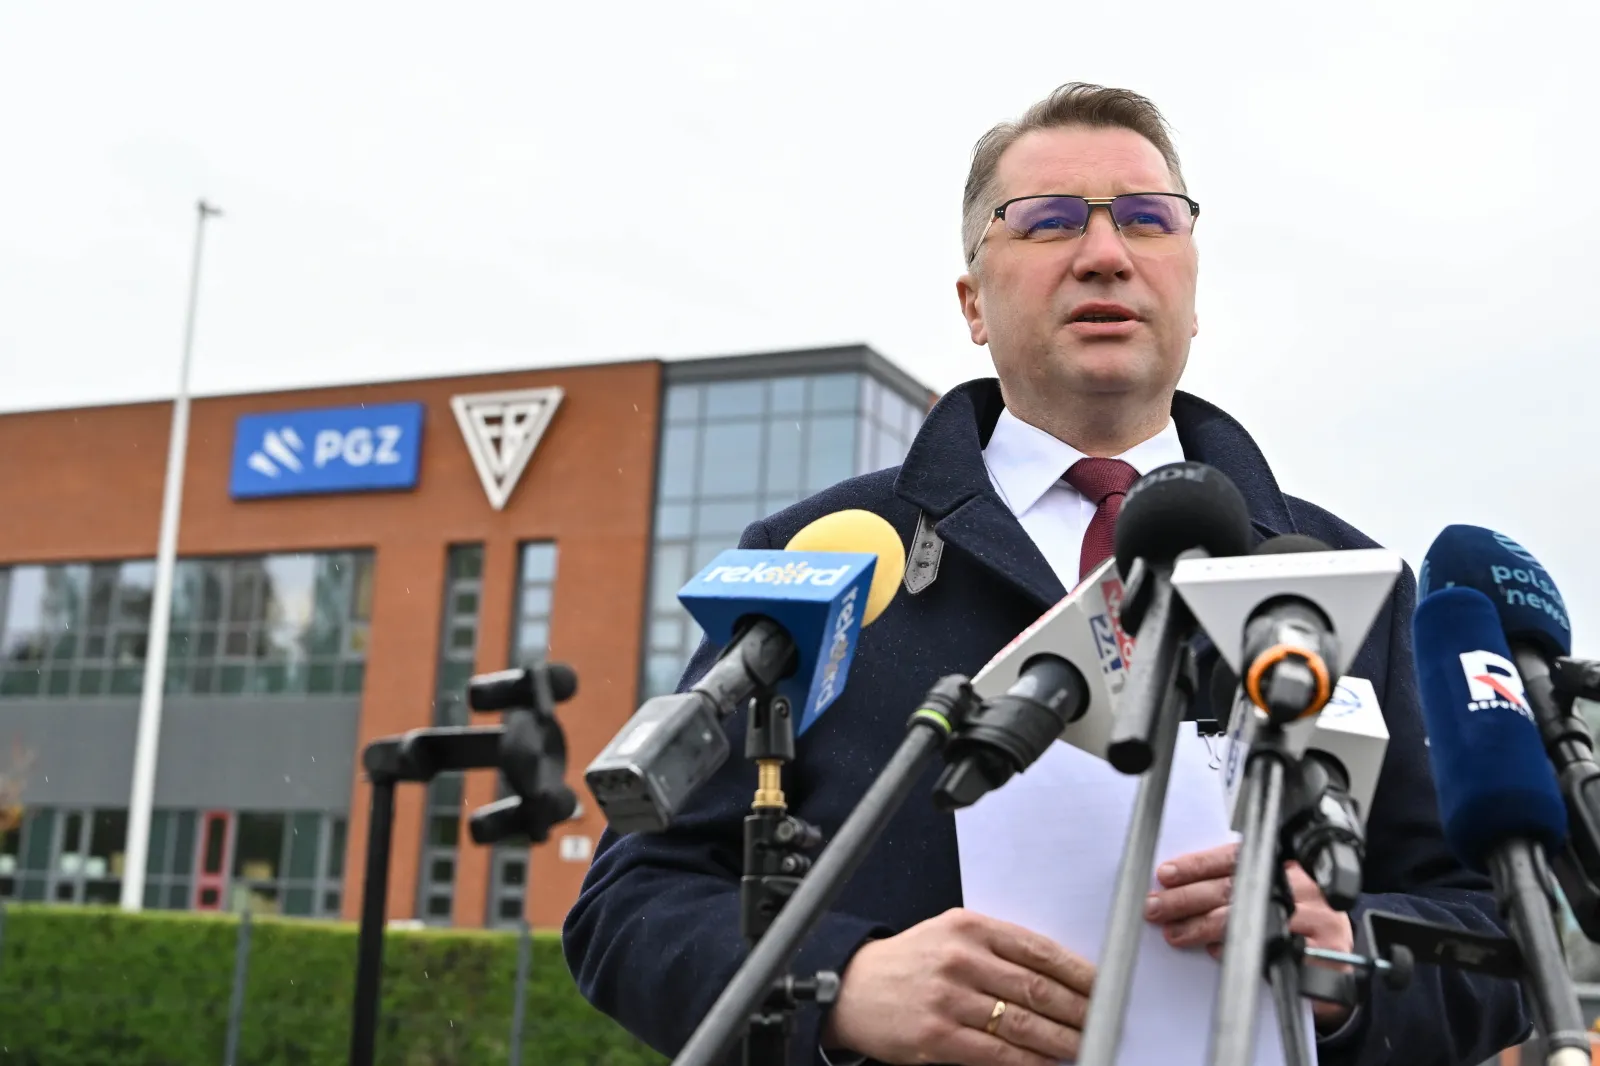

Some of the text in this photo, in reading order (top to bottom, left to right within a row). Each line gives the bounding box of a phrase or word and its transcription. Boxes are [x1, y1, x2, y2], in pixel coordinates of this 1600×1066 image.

[313, 425, 401, 468] PGZ
[1490, 564, 1566, 614] pols
[1506, 588, 1570, 630] news
